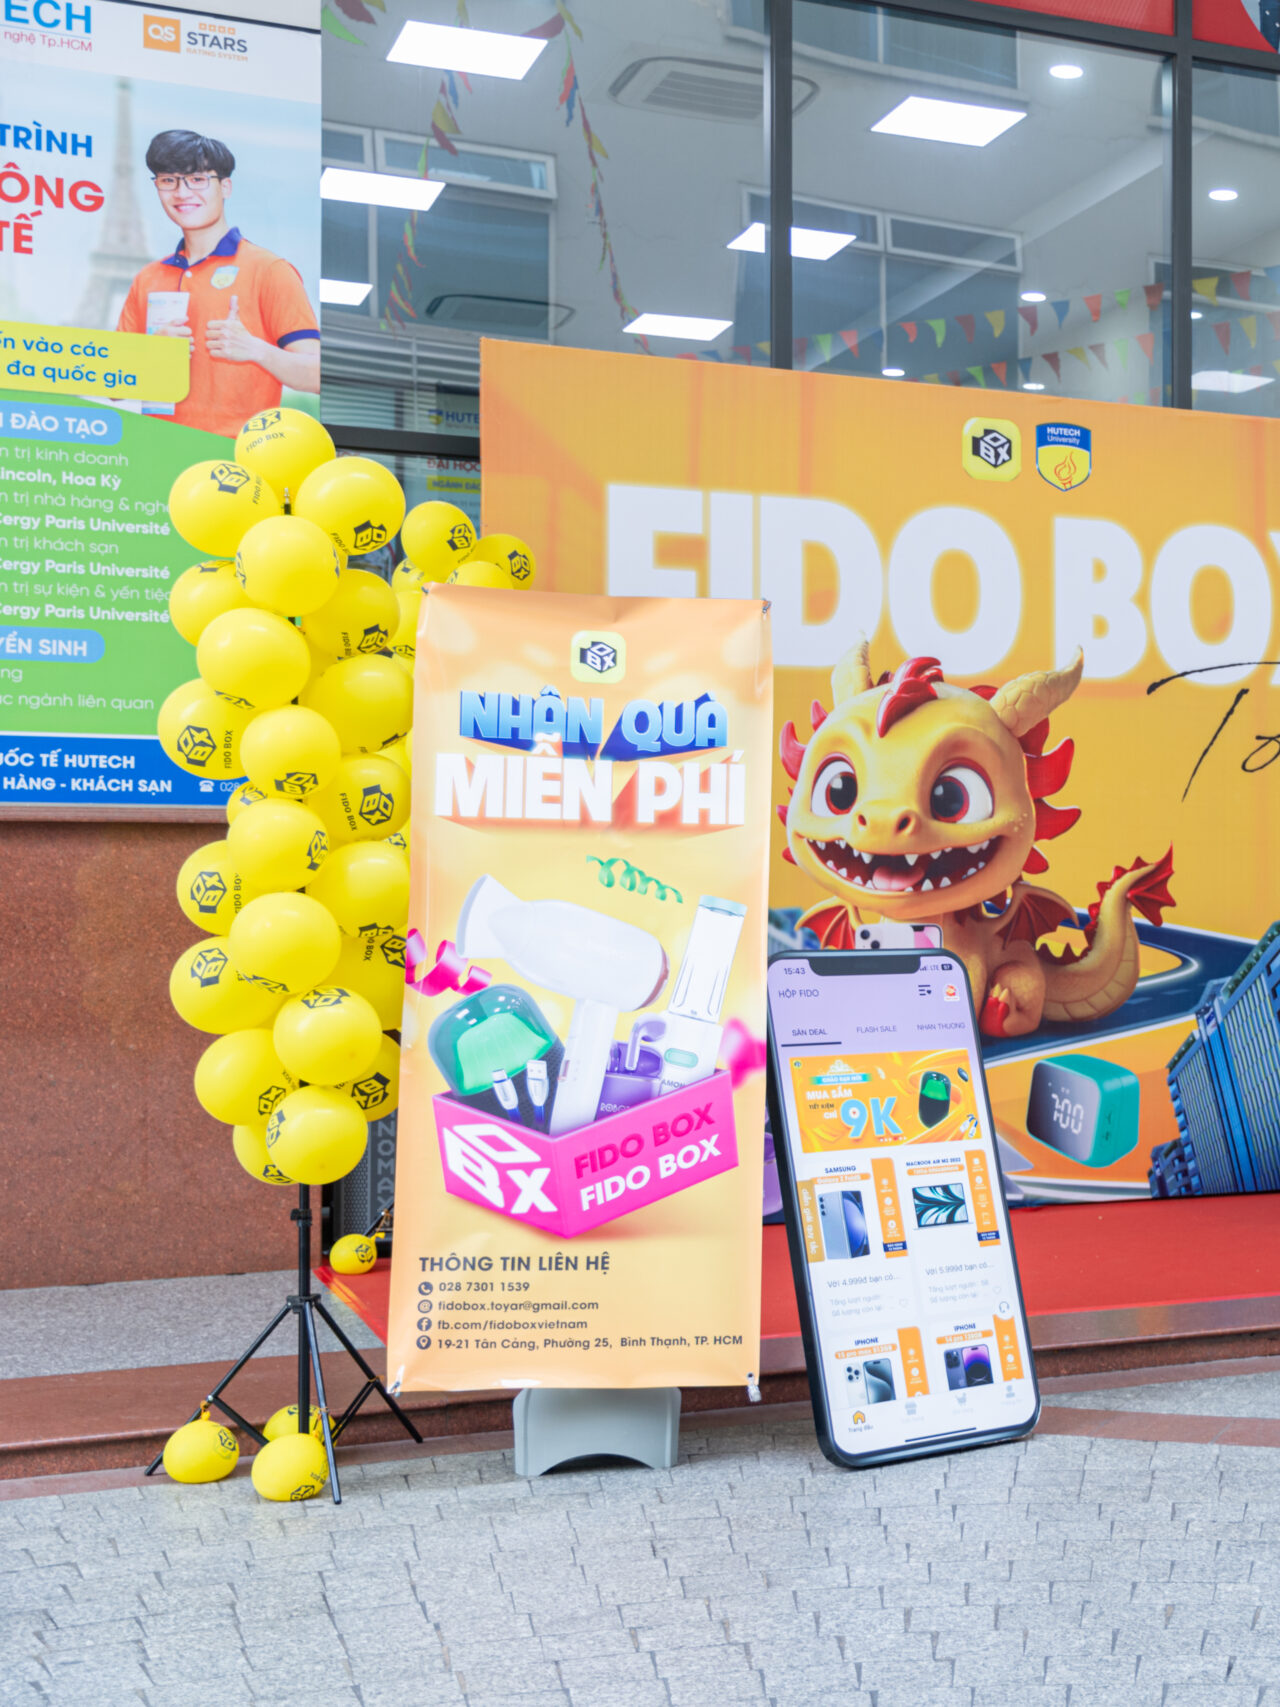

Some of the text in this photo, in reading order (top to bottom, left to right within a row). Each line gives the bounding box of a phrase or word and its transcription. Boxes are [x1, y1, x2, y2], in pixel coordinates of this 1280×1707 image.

[4, 30, 93, 52] nghệ Tp.HCM
[148, 23, 177, 43] QS
[187, 31, 248, 53] STARS
[23, 336, 109, 358] vào các
[6, 360, 137, 388] đa quốc gia
[10, 410, 108, 439] ĐÀO TẠO
[1046, 426, 1081, 437] HUTECH
[1046, 435, 1080, 445] University
[36, 447, 129, 467] kinh doanh
[62, 471, 121, 491] Hoa Kỳ
[45, 514, 171, 536] Paris Université
[34, 536, 85, 553] khách
[45, 559, 171, 580] Paris Université
[606, 483, 1023, 675] FIDO
[45, 604, 171, 624] Paris Université
[38, 638, 88, 656] SINH
[78, 693, 107, 709] liên
[111, 697, 154, 712] quan
[40, 747, 135, 769] TẾ HUTECH
[223, 729, 233, 770] FIDO BOX
[3, 774, 172, 796] HÀNG KHÁCH SẠN
[434, 733, 746, 827] MIỄN PHÍ
[339, 792, 358, 832] FIDO BOX
[784, 967, 806, 976] 15:43
[778, 988, 820, 999] HỘP FIDO
[809, 1025, 898, 1037] DEAL FLASH SALE
[806, 1090, 830, 1101] MUA
[840, 1096, 904, 1138] 9K
[574, 1102, 715, 1180] FIDO BOX
[580, 1133, 722, 1212] FIDO BOX
[824, 1165, 857, 1174] SAMSUNG
[419, 1251, 611, 1275] THÔNG TIN LIÊN HỆ
[438, 1281, 531, 1292] 028 7301 1539
[438, 1300, 599, 1313] fidobox.toyar@gmail.com
[437, 1319, 588, 1331] fb.com/fidoboxvietnam
[954, 1322, 977, 1332] IPHONE
[438, 1339, 469, 1349] 19-21
[475, 1338, 497, 1349] Tân
[543, 1337, 591, 1351] Phường
[594, 1338, 613, 1349] 25,
[620, 1336, 646, 1347] Bình
[650, 1336, 690, 1349] Thạnh,
[694, 1335, 710, 1346] TP.
[713, 1335, 743, 1345] HCM
[854, 1336, 879, 1346] IPHONE
